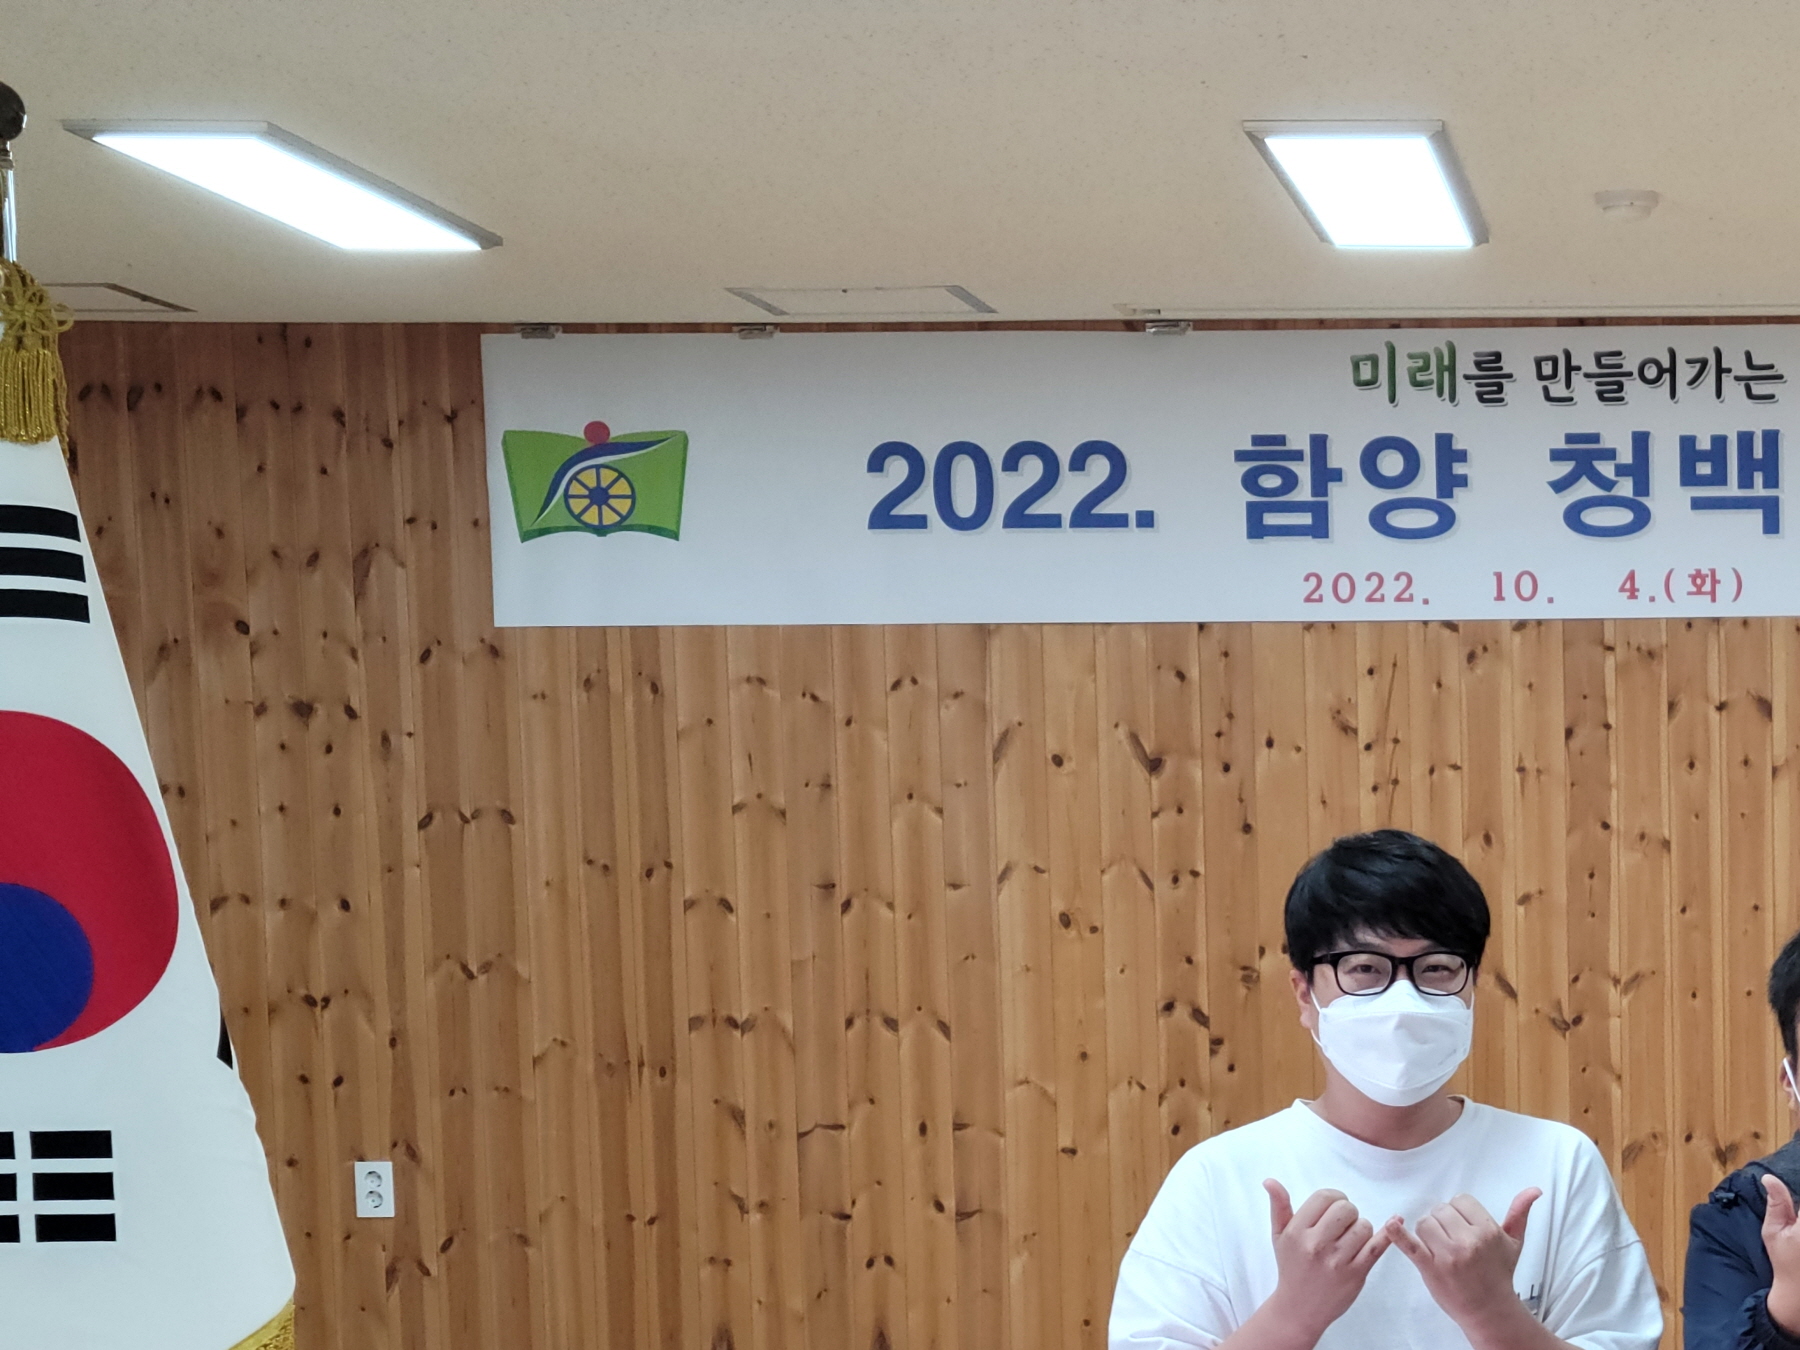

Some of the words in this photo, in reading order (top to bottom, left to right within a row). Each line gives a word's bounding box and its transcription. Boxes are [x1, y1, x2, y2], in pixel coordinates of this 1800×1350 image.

[1349, 340, 1513, 406] 미래를
[1532, 345, 1787, 404] 만들어가는
[866, 439, 1156, 532] 2022.
[1233, 432, 1471, 541] 함양
[1302, 570, 1430, 605] 2022.
[1491, 569, 1555, 604] 10.
[1618, 568, 1744, 604] 4.(화)
